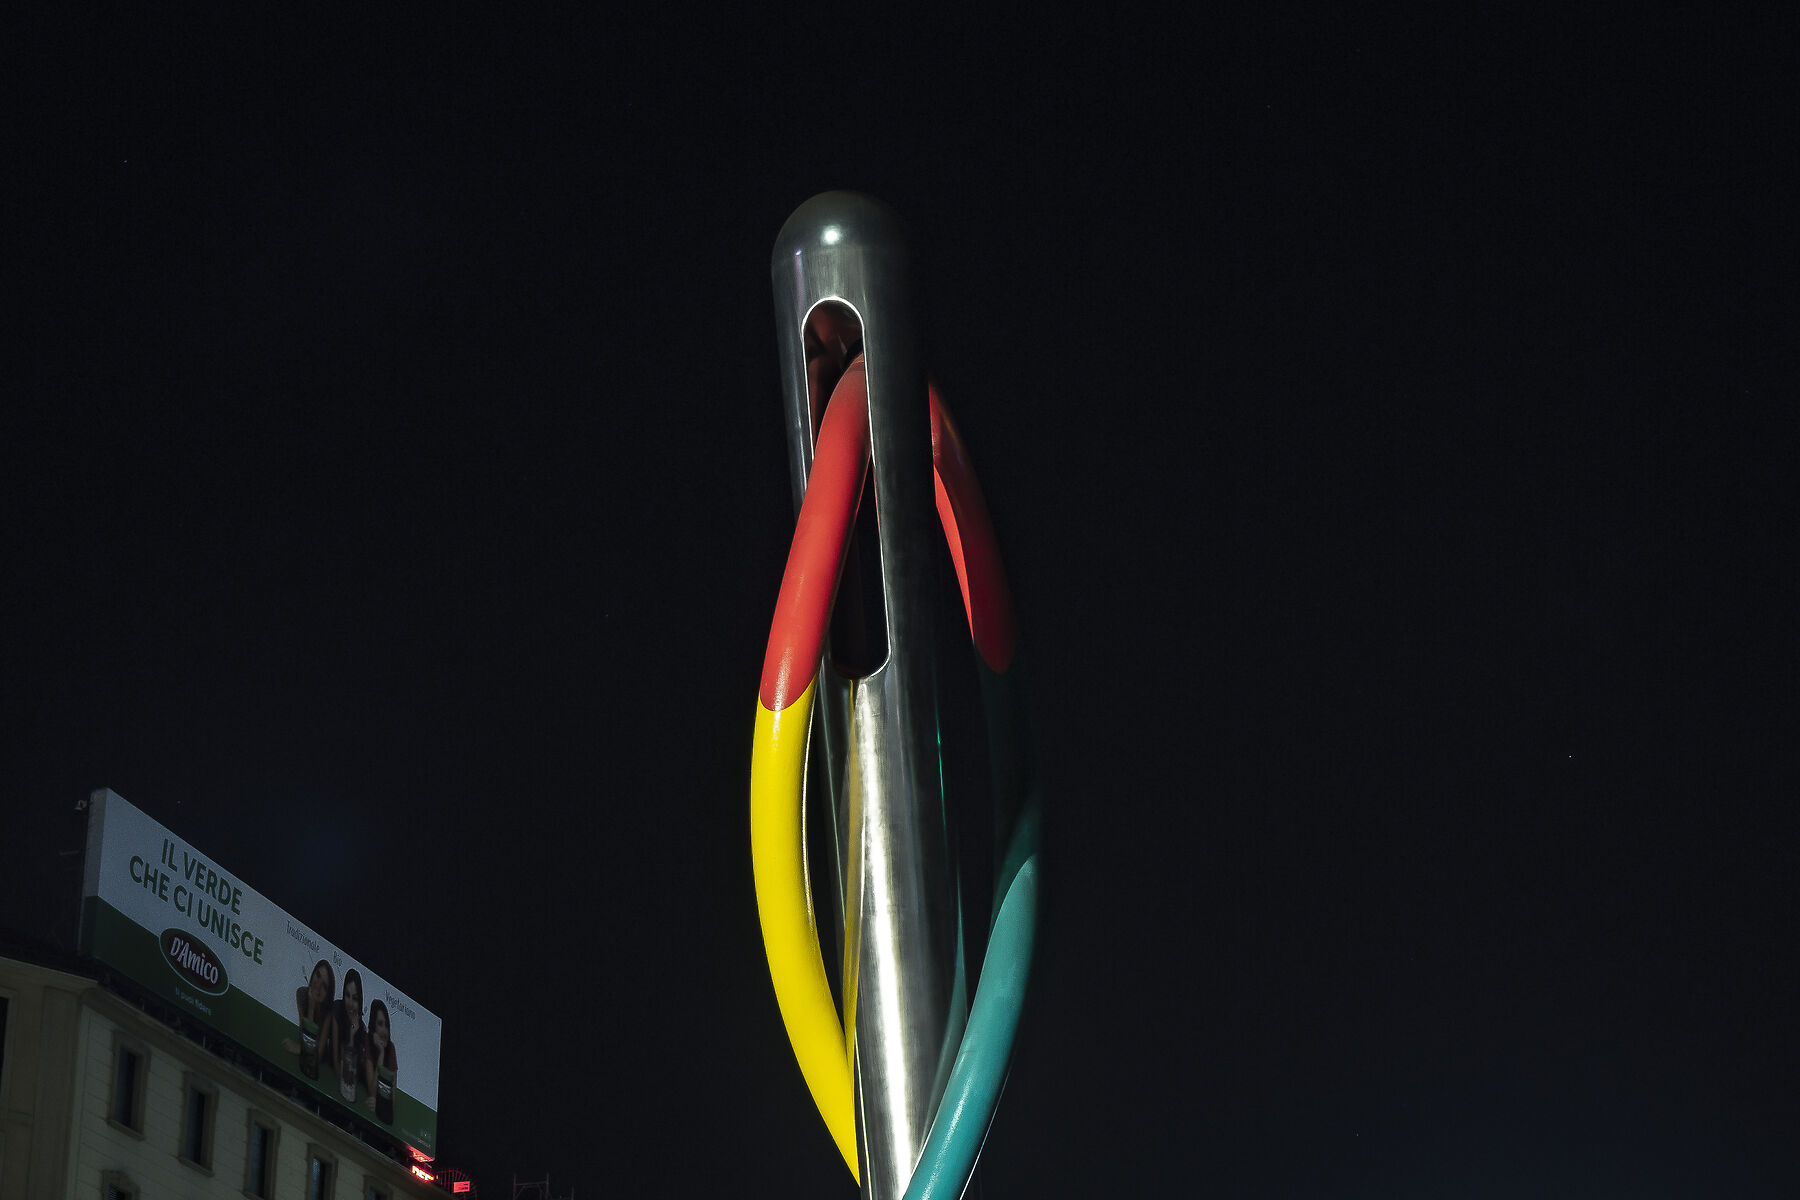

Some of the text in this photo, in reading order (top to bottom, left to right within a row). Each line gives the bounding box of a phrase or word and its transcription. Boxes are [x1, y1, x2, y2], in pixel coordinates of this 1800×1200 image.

[129, 855, 264, 965] CHE CI UNISCE
[161, 838, 242, 915] IL VERDE
[170, 936, 219, 985] D'Amico
